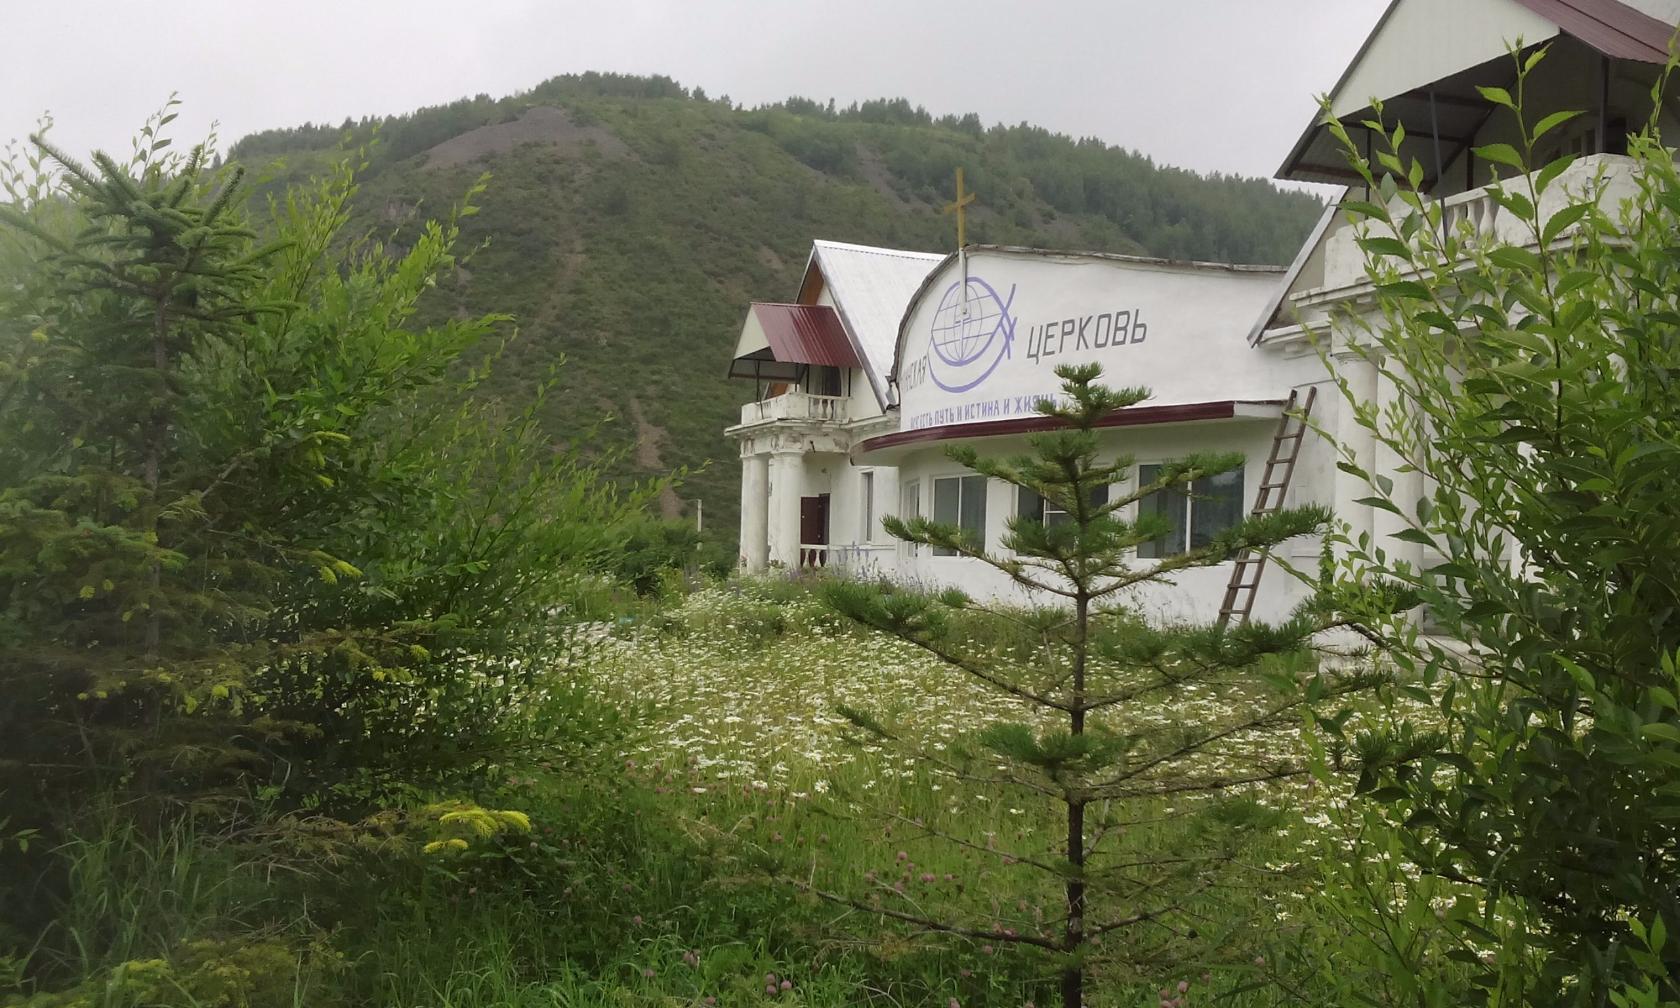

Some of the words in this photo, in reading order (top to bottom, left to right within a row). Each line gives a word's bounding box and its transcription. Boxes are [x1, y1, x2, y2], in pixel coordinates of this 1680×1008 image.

[1026, 308, 1147, 365] ЦЕРКОВЬ
[935, 407, 955, 425] ПУТЬ
[957, 405, 962, 420] И
[965, 400, 999, 420] ИСТИНА
[1004, 399, 1010, 415] И
